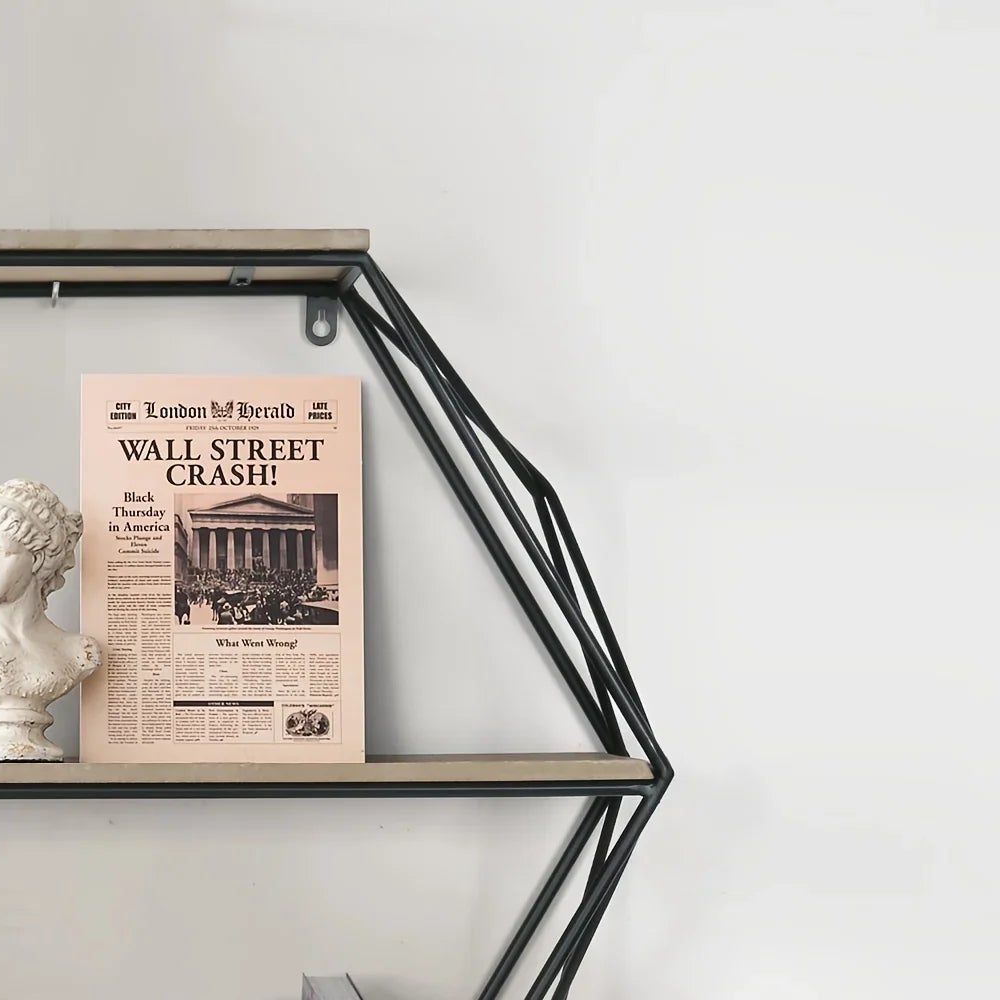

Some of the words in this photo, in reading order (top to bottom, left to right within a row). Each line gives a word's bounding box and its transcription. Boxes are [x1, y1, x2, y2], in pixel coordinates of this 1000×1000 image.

[115, 402, 131, 410] CITY
[143, 401, 207, 420] London
[236, 401, 295, 422] Herald
[312, 402, 328, 410] LATE
[110, 412, 137, 420] EDITION
[307, 411, 333, 420] PRICES
[118, 438, 201, 461] WALL
[210, 438, 325, 461] STREET
[166, 464, 277, 486] CRASH!
[123, 491, 155, 503] Black
[112, 506, 166, 520] Thursday
[108, 521, 119, 532] in
[123, 521, 170, 532] America
[215, 638, 239, 648] What
[241, 638, 264, 648] Went
[266, 638, 298, 650] Wrong?
